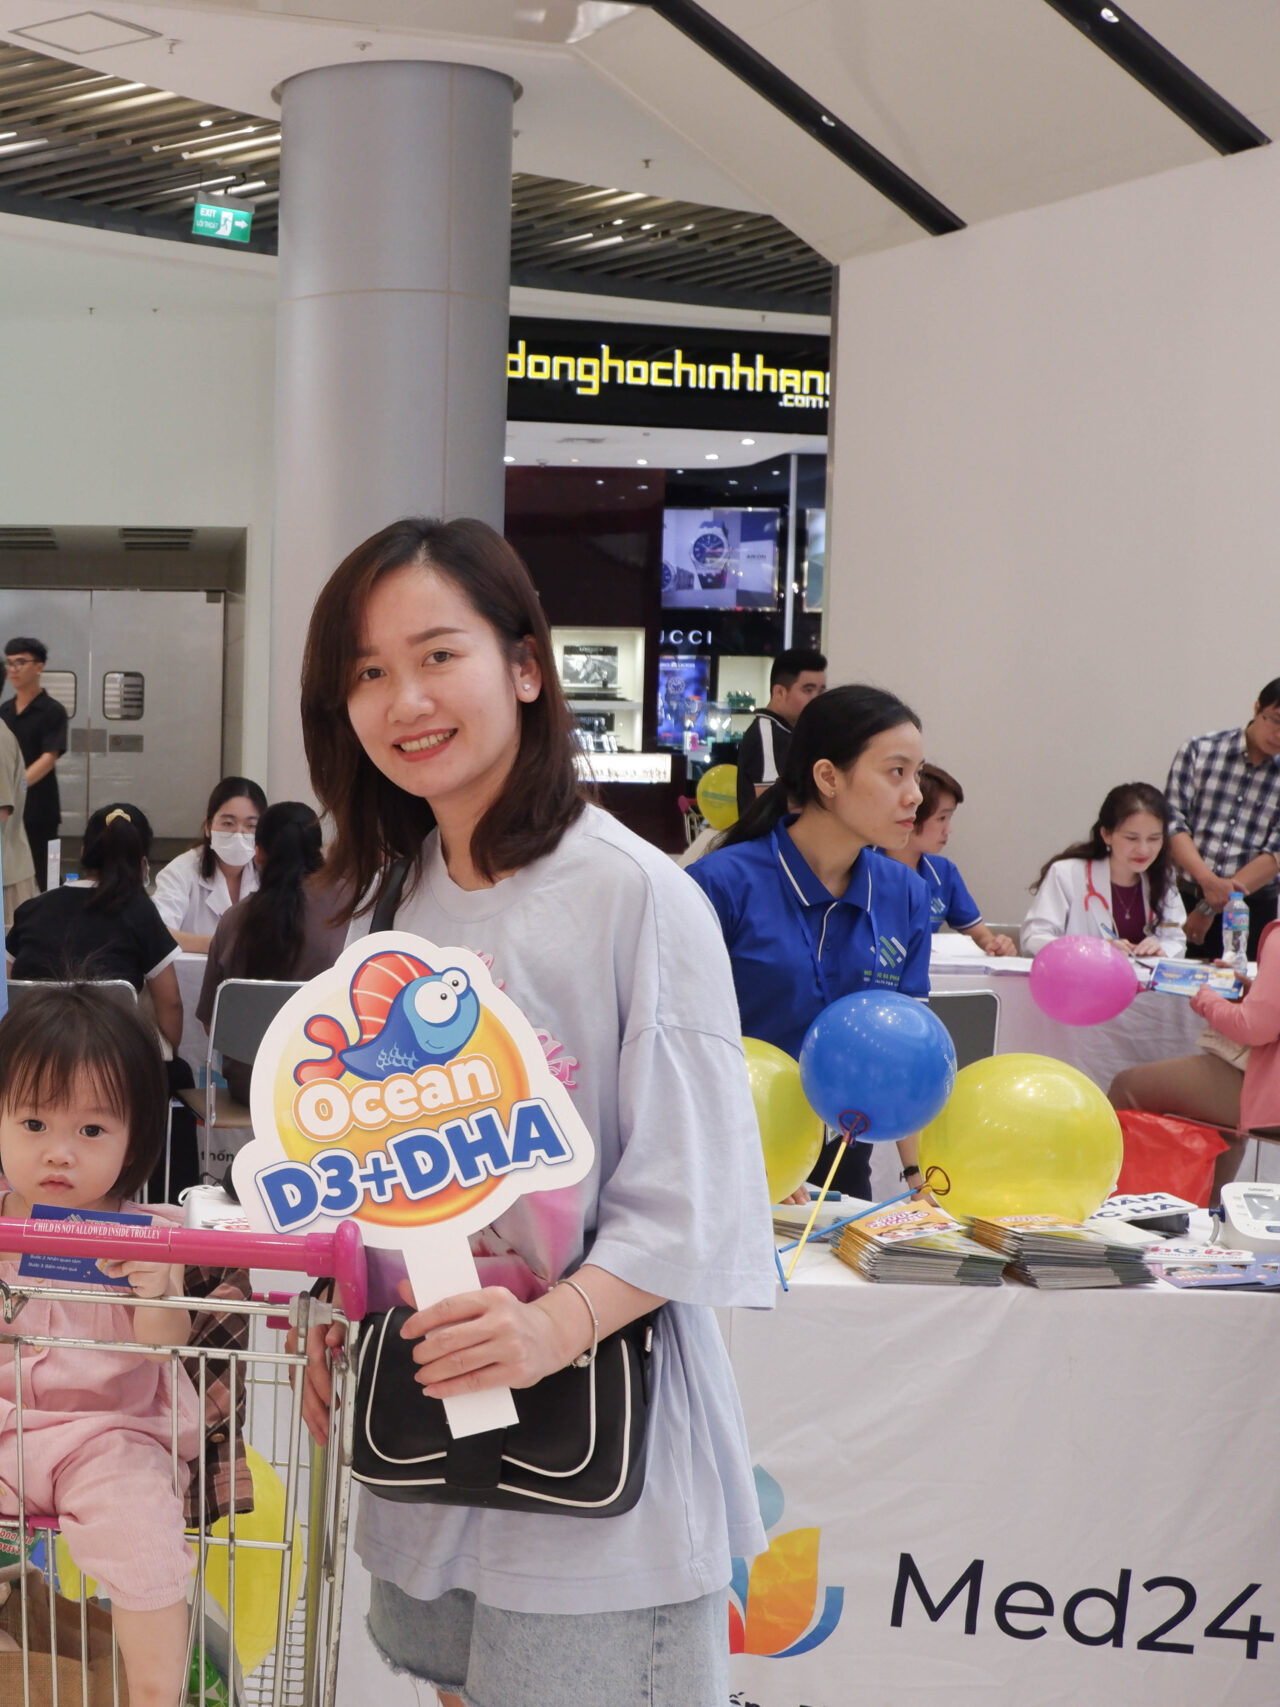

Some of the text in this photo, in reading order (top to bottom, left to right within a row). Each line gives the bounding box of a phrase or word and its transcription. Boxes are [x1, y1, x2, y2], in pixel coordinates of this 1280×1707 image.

[200, 207, 217, 217] EXIT
[507, 340, 830, 395] donghochinhhan
[298, 1058, 496, 1137] Ocean
[262, 1104, 567, 1227] D3+DHA
[33, 1222, 161, 1240] CHILD IS NOT ALLOWED INSIDE TROLLEY
[890, 1552, 1275, 1660] Med24
